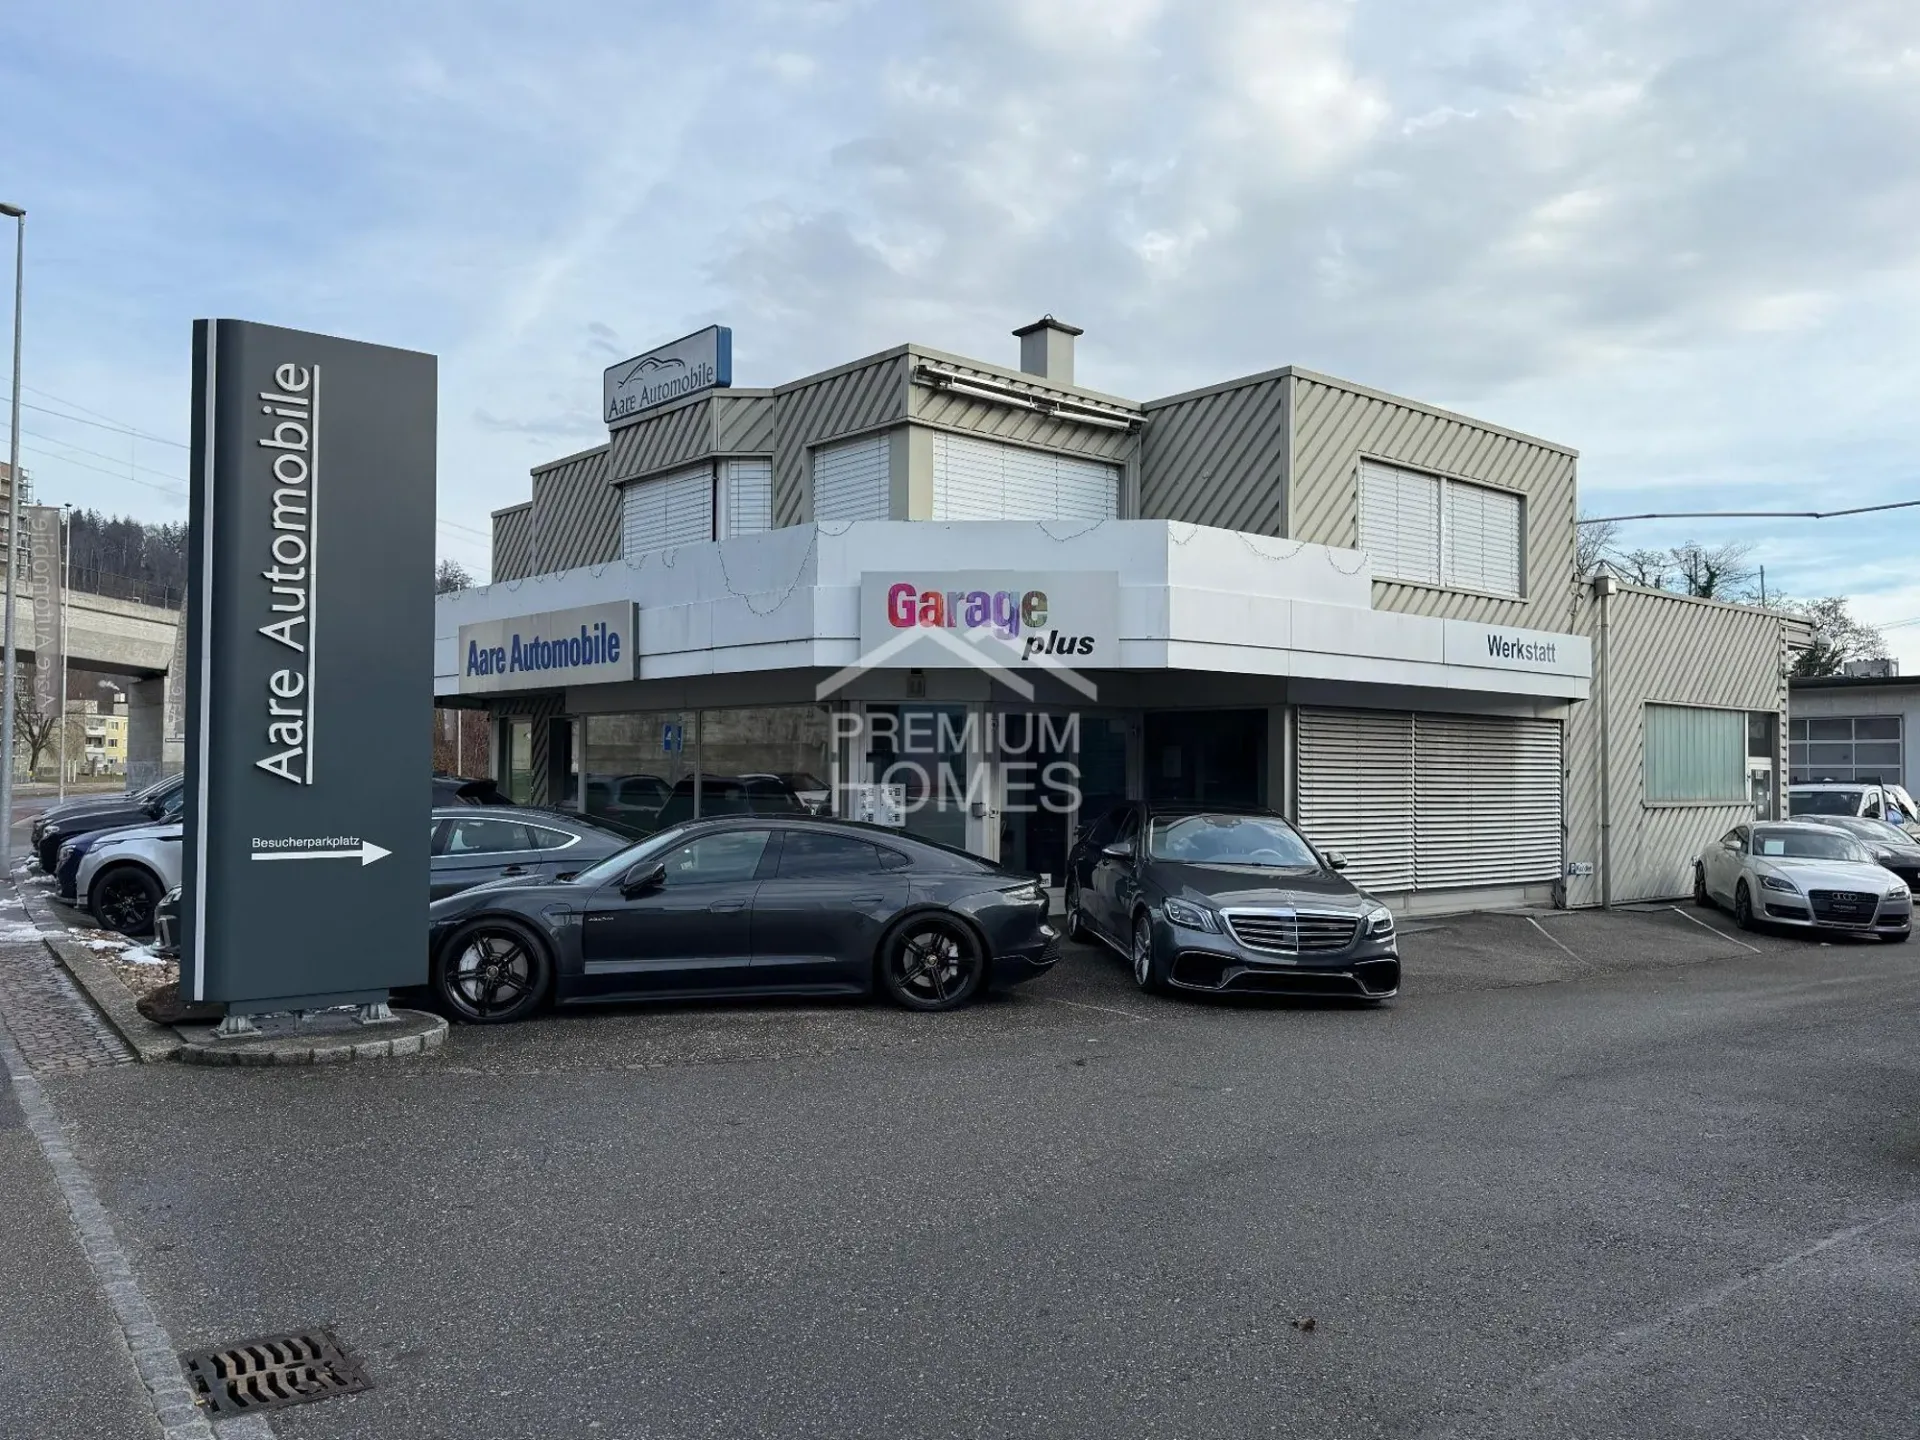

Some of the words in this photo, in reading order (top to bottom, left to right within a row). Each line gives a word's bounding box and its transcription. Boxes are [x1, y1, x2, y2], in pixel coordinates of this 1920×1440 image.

[608, 395, 637, 419] Aare
[640, 362, 714, 407] Automobile
[258, 362, 310, 653] Automobile
[887, 583, 1048, 640] Garage
[466, 639, 506, 677] Aare
[509, 622, 621, 673] Automobile
[1021, 629, 1095, 660] plus
[1487, 634, 1556, 663] Werkstatt
[256, 668, 304, 785] Aare
[251, 836, 360, 849] Besucherparkplatz
